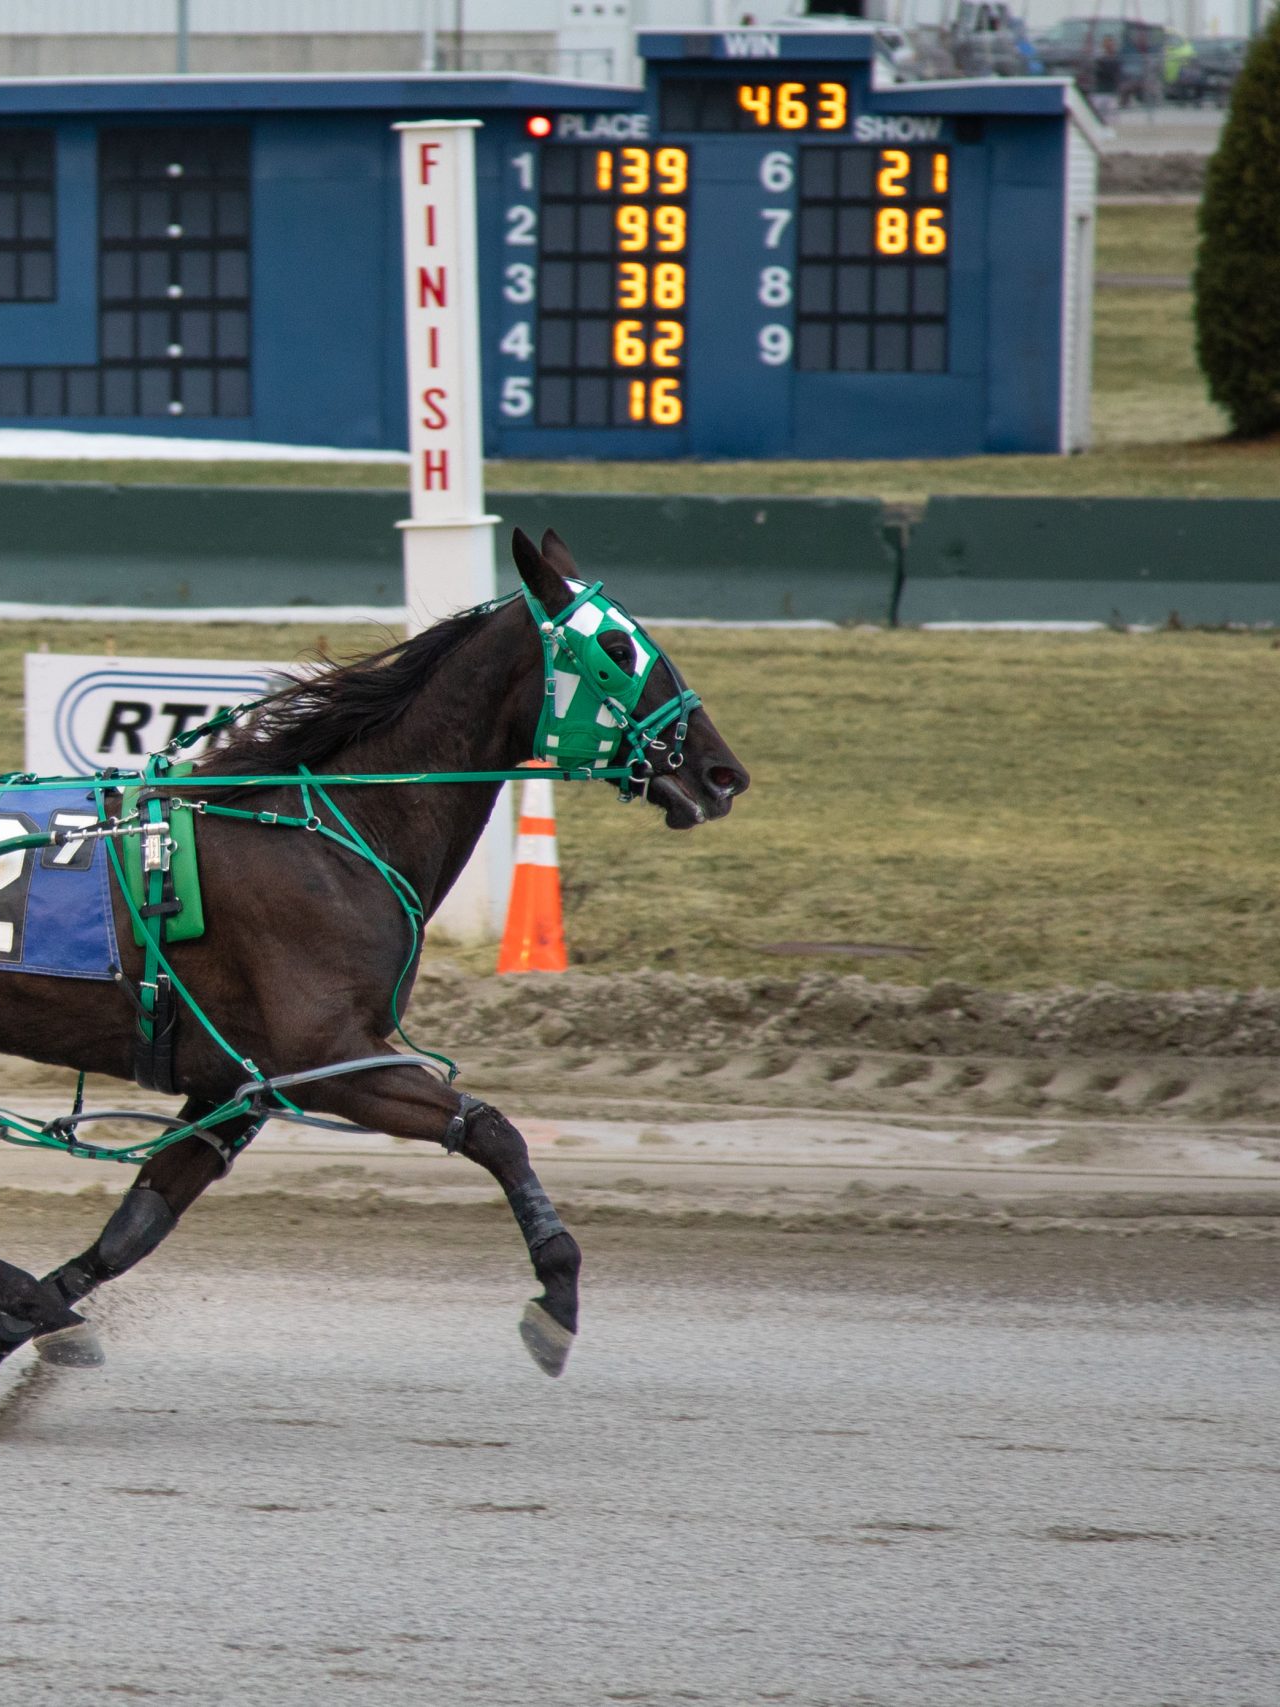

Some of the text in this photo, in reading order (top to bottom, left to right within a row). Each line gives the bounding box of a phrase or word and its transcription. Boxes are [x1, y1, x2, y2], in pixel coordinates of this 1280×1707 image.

[723, 34, 781, 57] WIN
[557, 114, 651, 141] PLACE
[738, 82, 847, 130] 463
[853, 115, 940, 143] SHOW
[511, 147, 688, 195] 1 139
[760, 149, 948, 197] 6 21
[506, 205, 687, 253] 2 99
[760, 207, 947, 255] 7 86
[504, 262, 686, 310] 3 38
[758, 266, 792, 307] 8
[419, 143, 450, 491] FINISH
[500, 319, 684, 367] 4 62
[758, 324, 792, 365] 9
[501, 376, 683, 425] 5 16
[52, 813, 100, 866] 7
